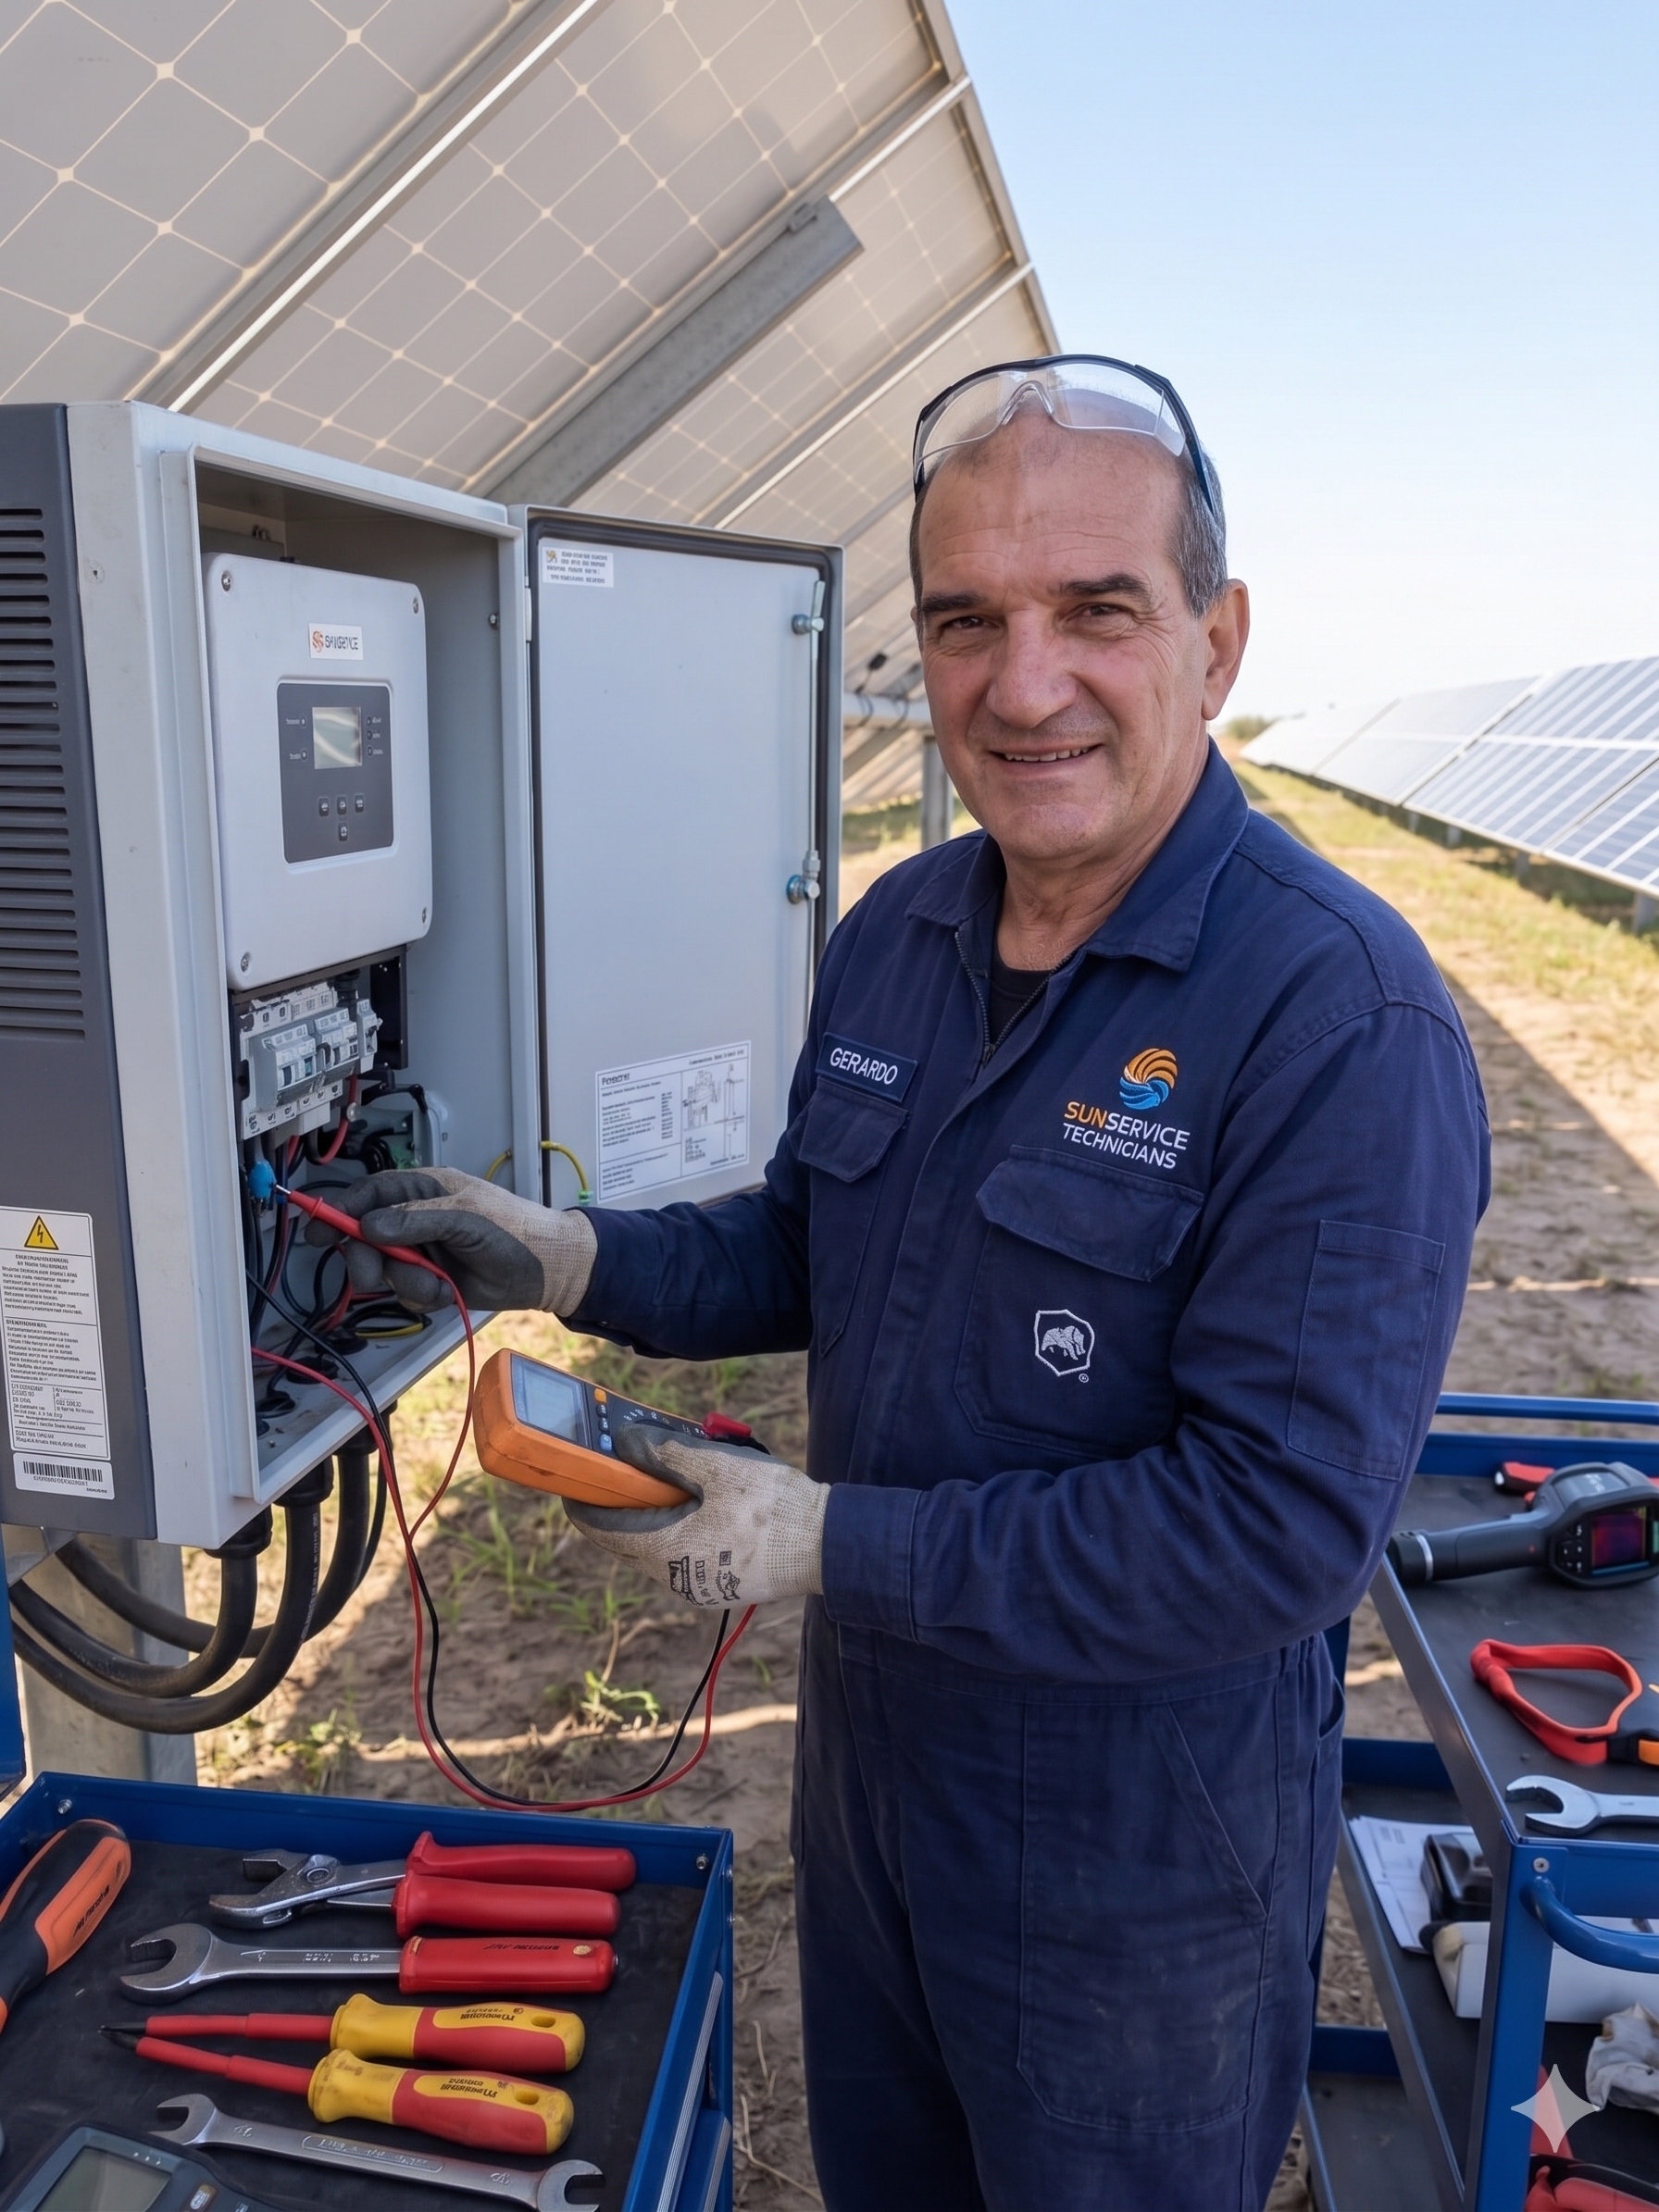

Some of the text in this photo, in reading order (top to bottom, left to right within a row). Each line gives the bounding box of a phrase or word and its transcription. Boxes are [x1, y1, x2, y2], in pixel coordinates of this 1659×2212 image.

[830, 1047, 899, 1086] GERARDO
[1062, 1122, 1178, 1170] TECHNICIANS
[1064, 1100, 1191, 1151] SUNSERVICE
